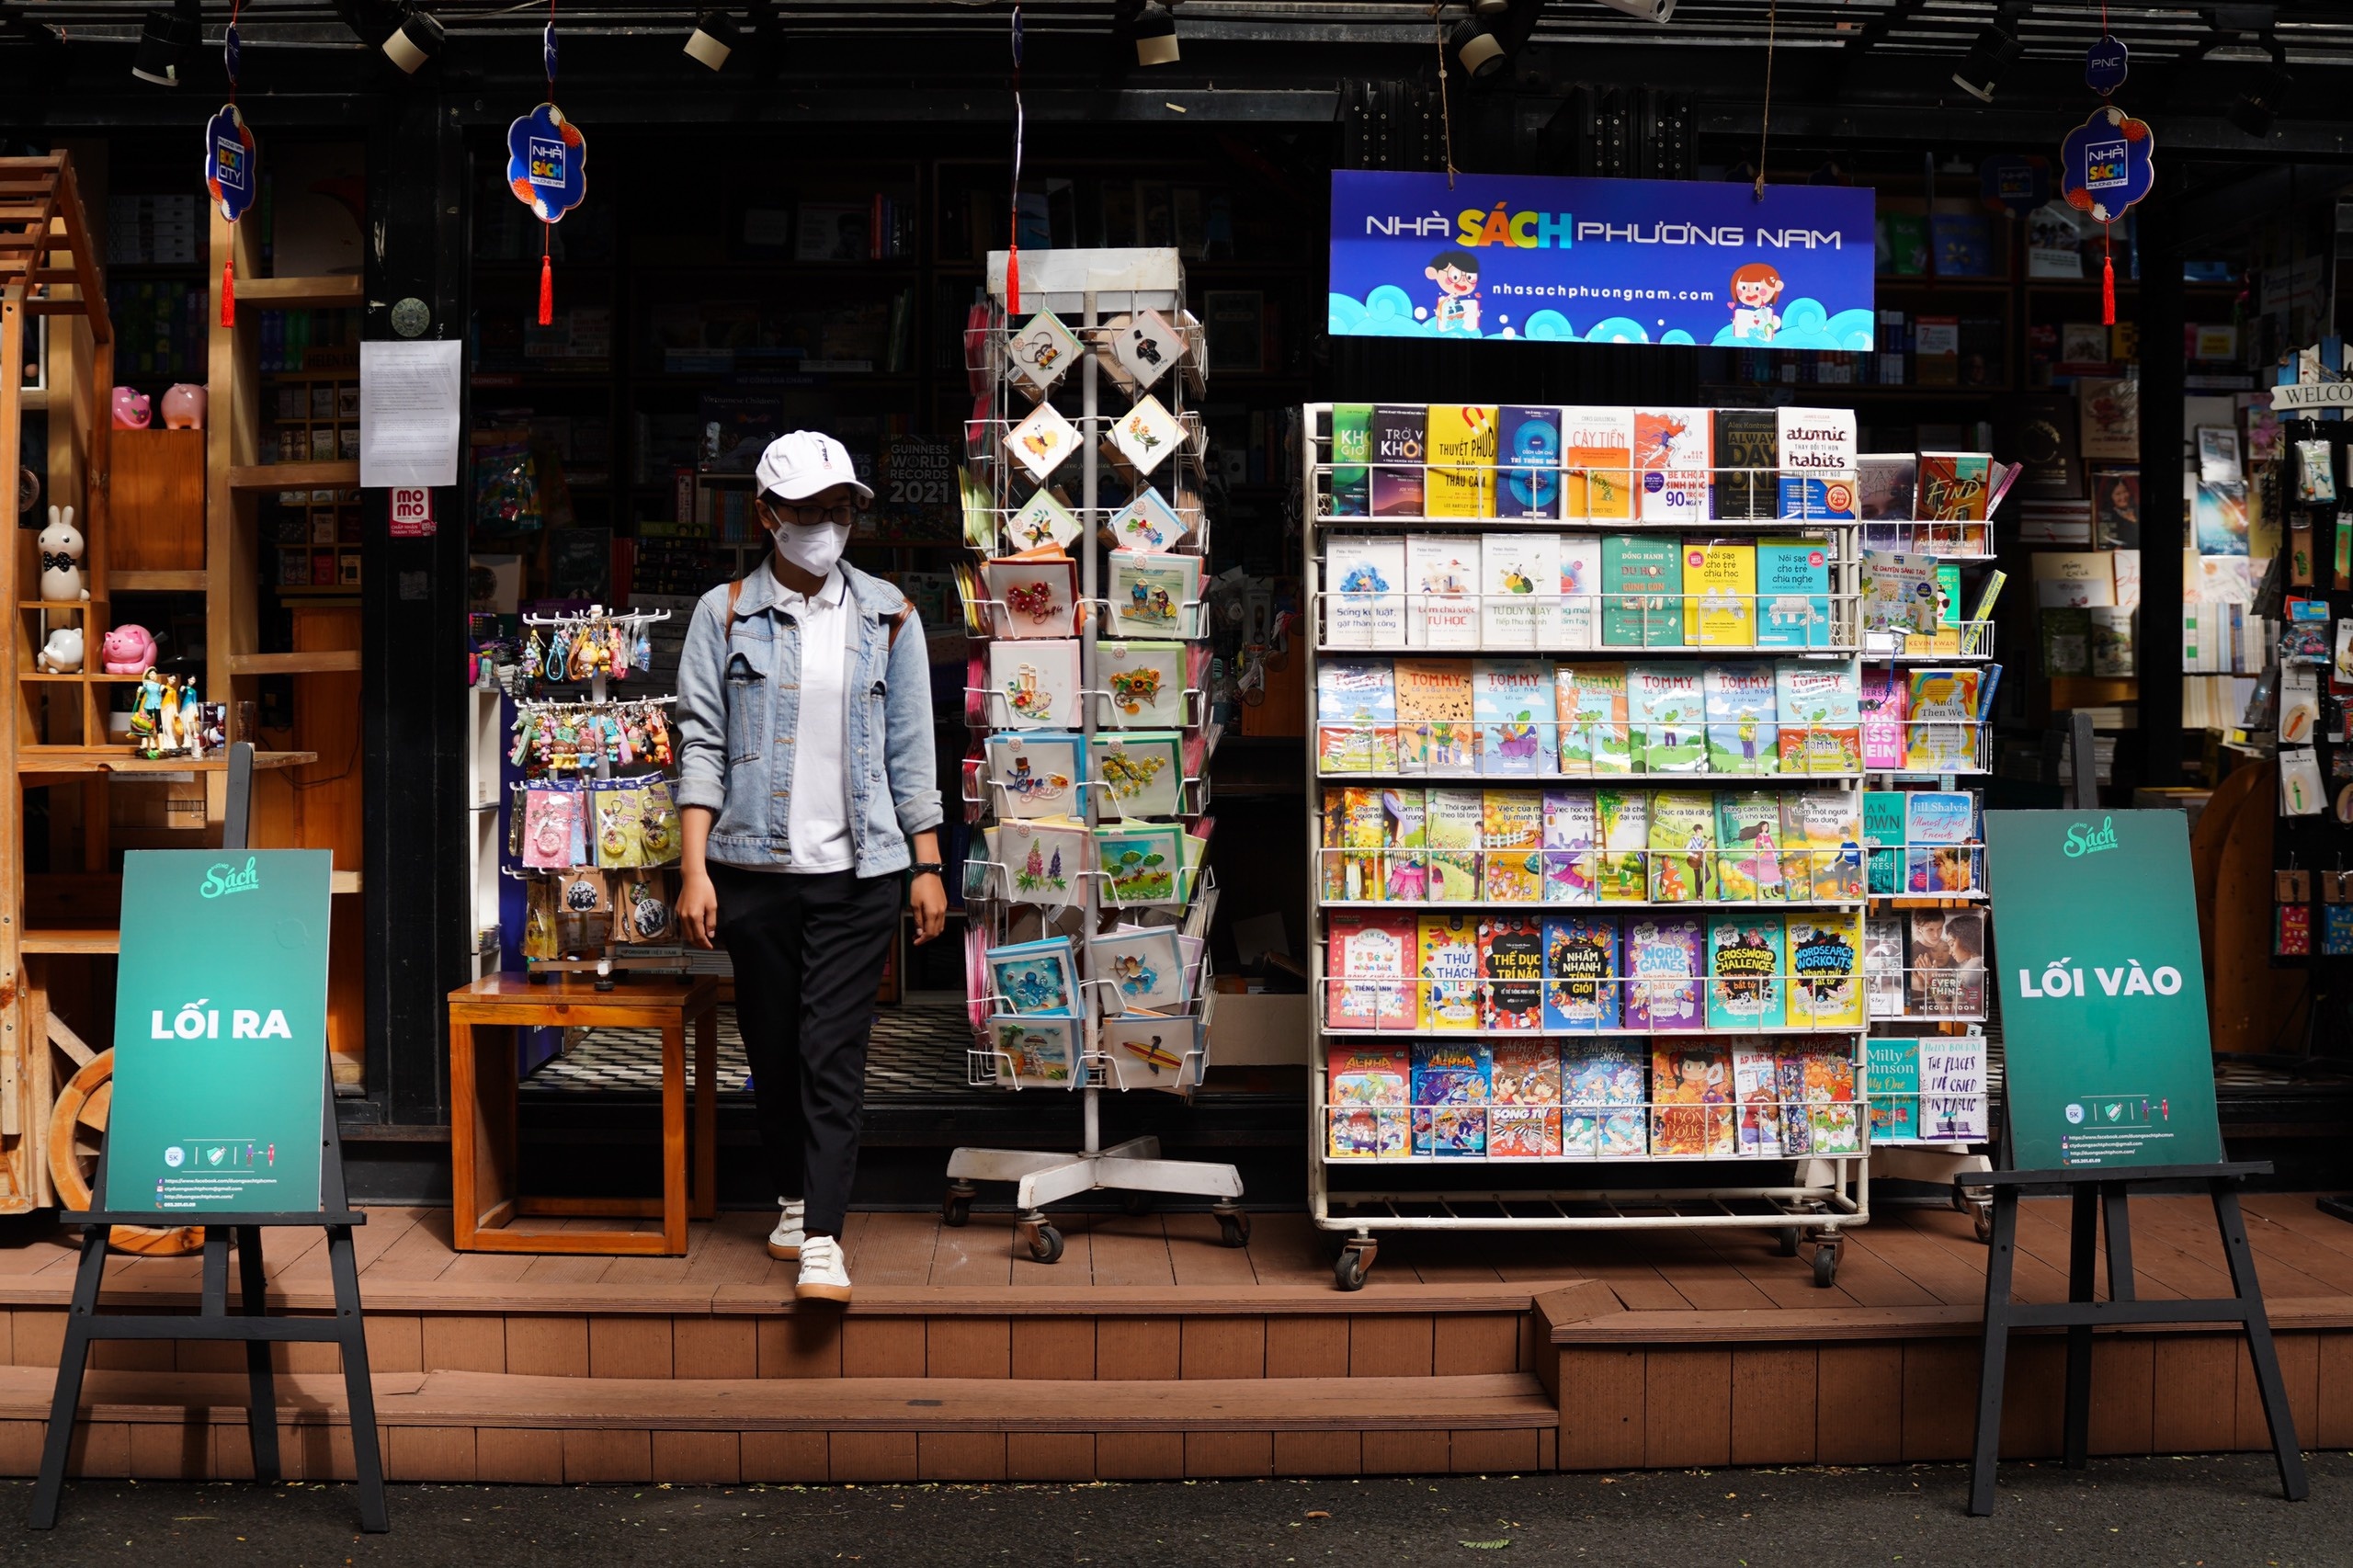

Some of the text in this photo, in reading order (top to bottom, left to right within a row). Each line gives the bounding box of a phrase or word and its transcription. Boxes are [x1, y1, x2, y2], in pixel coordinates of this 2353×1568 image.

[2091, 57, 2120, 69] PNC
[220, 148, 241, 169] BOOK
[532, 145, 563, 160] NHÀ
[2088, 144, 2124, 162] NHÀ
[220, 165, 241, 183] CITY
[532, 159, 563, 178] SÁCH
[2088, 161, 2125, 181] SÁCH
[1366, 201, 1841, 250] NHÀ SÁCH PHƯƠNG NAM
[1492, 283, 1714, 301] nhasachphuongnam.com
[307, 353, 339, 369] HELEN
[2285, 385, 2353, 404] WELCO
[1385, 426, 1411, 440] TRỞ
[1573, 428, 1625, 449] CÂY TIỀN
[1787, 426, 1847, 441] atomic
[891, 444, 949, 455] GUINNESS
[1439, 426, 1495, 460] THUYẾT PHỤC
[891, 455, 949, 468] WORLD
[1789, 451, 1846, 468] habits
[890, 469, 949, 479] RECORDS
[1446, 472, 1466, 487] THẤU
[890, 480, 949, 504] 2021
[1665, 491, 1685, 506] 90
[1918, 538, 1944, 547] André
[1946, 538, 1976, 547] Aciman
[1621, 551, 1664, 560] ĐỒNG HÀNH
[1706, 559, 1736, 569] cho trẻ
[1795, 563, 1807, 573] trẻ
[1704, 570, 1739, 580] chịu học
[1772, 574, 1813, 585] chịu nghe
[1648, 583, 1665, 591] CON
[1337, 608, 1360, 617] Sống
[1439, 605, 1475, 614] chủ việc
[1493, 606, 1524, 615] TƯ DUY
[1378, 619, 1396, 629] công
[1444, 616, 1467, 629] HỌC
[1410, 674, 1461, 687] TOMMY
[1487, 673, 1540, 686] TOMMY
[1573, 676, 1621, 688] TOMMY
[1643, 676, 1693, 688] TOMMY
[1720, 676, 1769, 688] TOMMY
[1933, 699, 1952, 707] And
[1921, 709, 1962, 717] Then We
[1803, 740, 1839, 751] TOMMY
[1912, 801, 1968, 813] Jill Shalvis
[1822, 816, 1838, 824] dung
[1912, 816, 1966, 829] Almost Just
[2063, 815, 2118, 858] Sách
[199, 856, 259, 899] Sách
[640, 899, 654, 912] BTS
[1635, 925, 1655, 937] Clever
[1641, 931, 1654, 942] Kids
[1715, 925, 1735, 937] Clever
[1722, 931, 1734, 942] Kids
[1790, 925, 1811, 937] Clever
[1796, 931, 1810, 942] Kids
[1443, 950, 1472, 964] THỬ
[1493, 949, 1540, 968] THỂ DỤC
[1566, 949, 1598, 962] NHẨM
[1643, 947, 1683, 960] WORD
[1716, 948, 1774, 961] CROSSWORD
[1795, 946, 1855, 959] WORDSEARCH
[1563, 962, 1601, 972] NHANH
[1639, 959, 1687, 972] GAMES
[1714, 960, 1776, 973] CHALLENGES
[1796, 955, 1852, 969] WORKOUTS
[1437, 965, 1478, 978] THÁCH
[1496, 966, 1540, 979] TRÍ NÃO
[2018, 957, 2182, 998] LỐI VÀO
[1442, 981, 1474, 992] STEM
[1931, 978, 1962, 987] EVERY
[1931, 987, 1963, 995] THING
[151, 998, 292, 1040] LỐI RA
[1343, 1054, 1392, 1072] ALPHA
[1428, 1053, 1478, 1071] ALPHA
[1868, 1049, 1903, 1064] Milly
[1927, 1055, 1976, 1074] THE PLACES
[1884, 1076, 1905, 1089] One
[1949, 1077, 1977, 1092] CRIED
[1492, 1108, 1530, 1119] SONG
